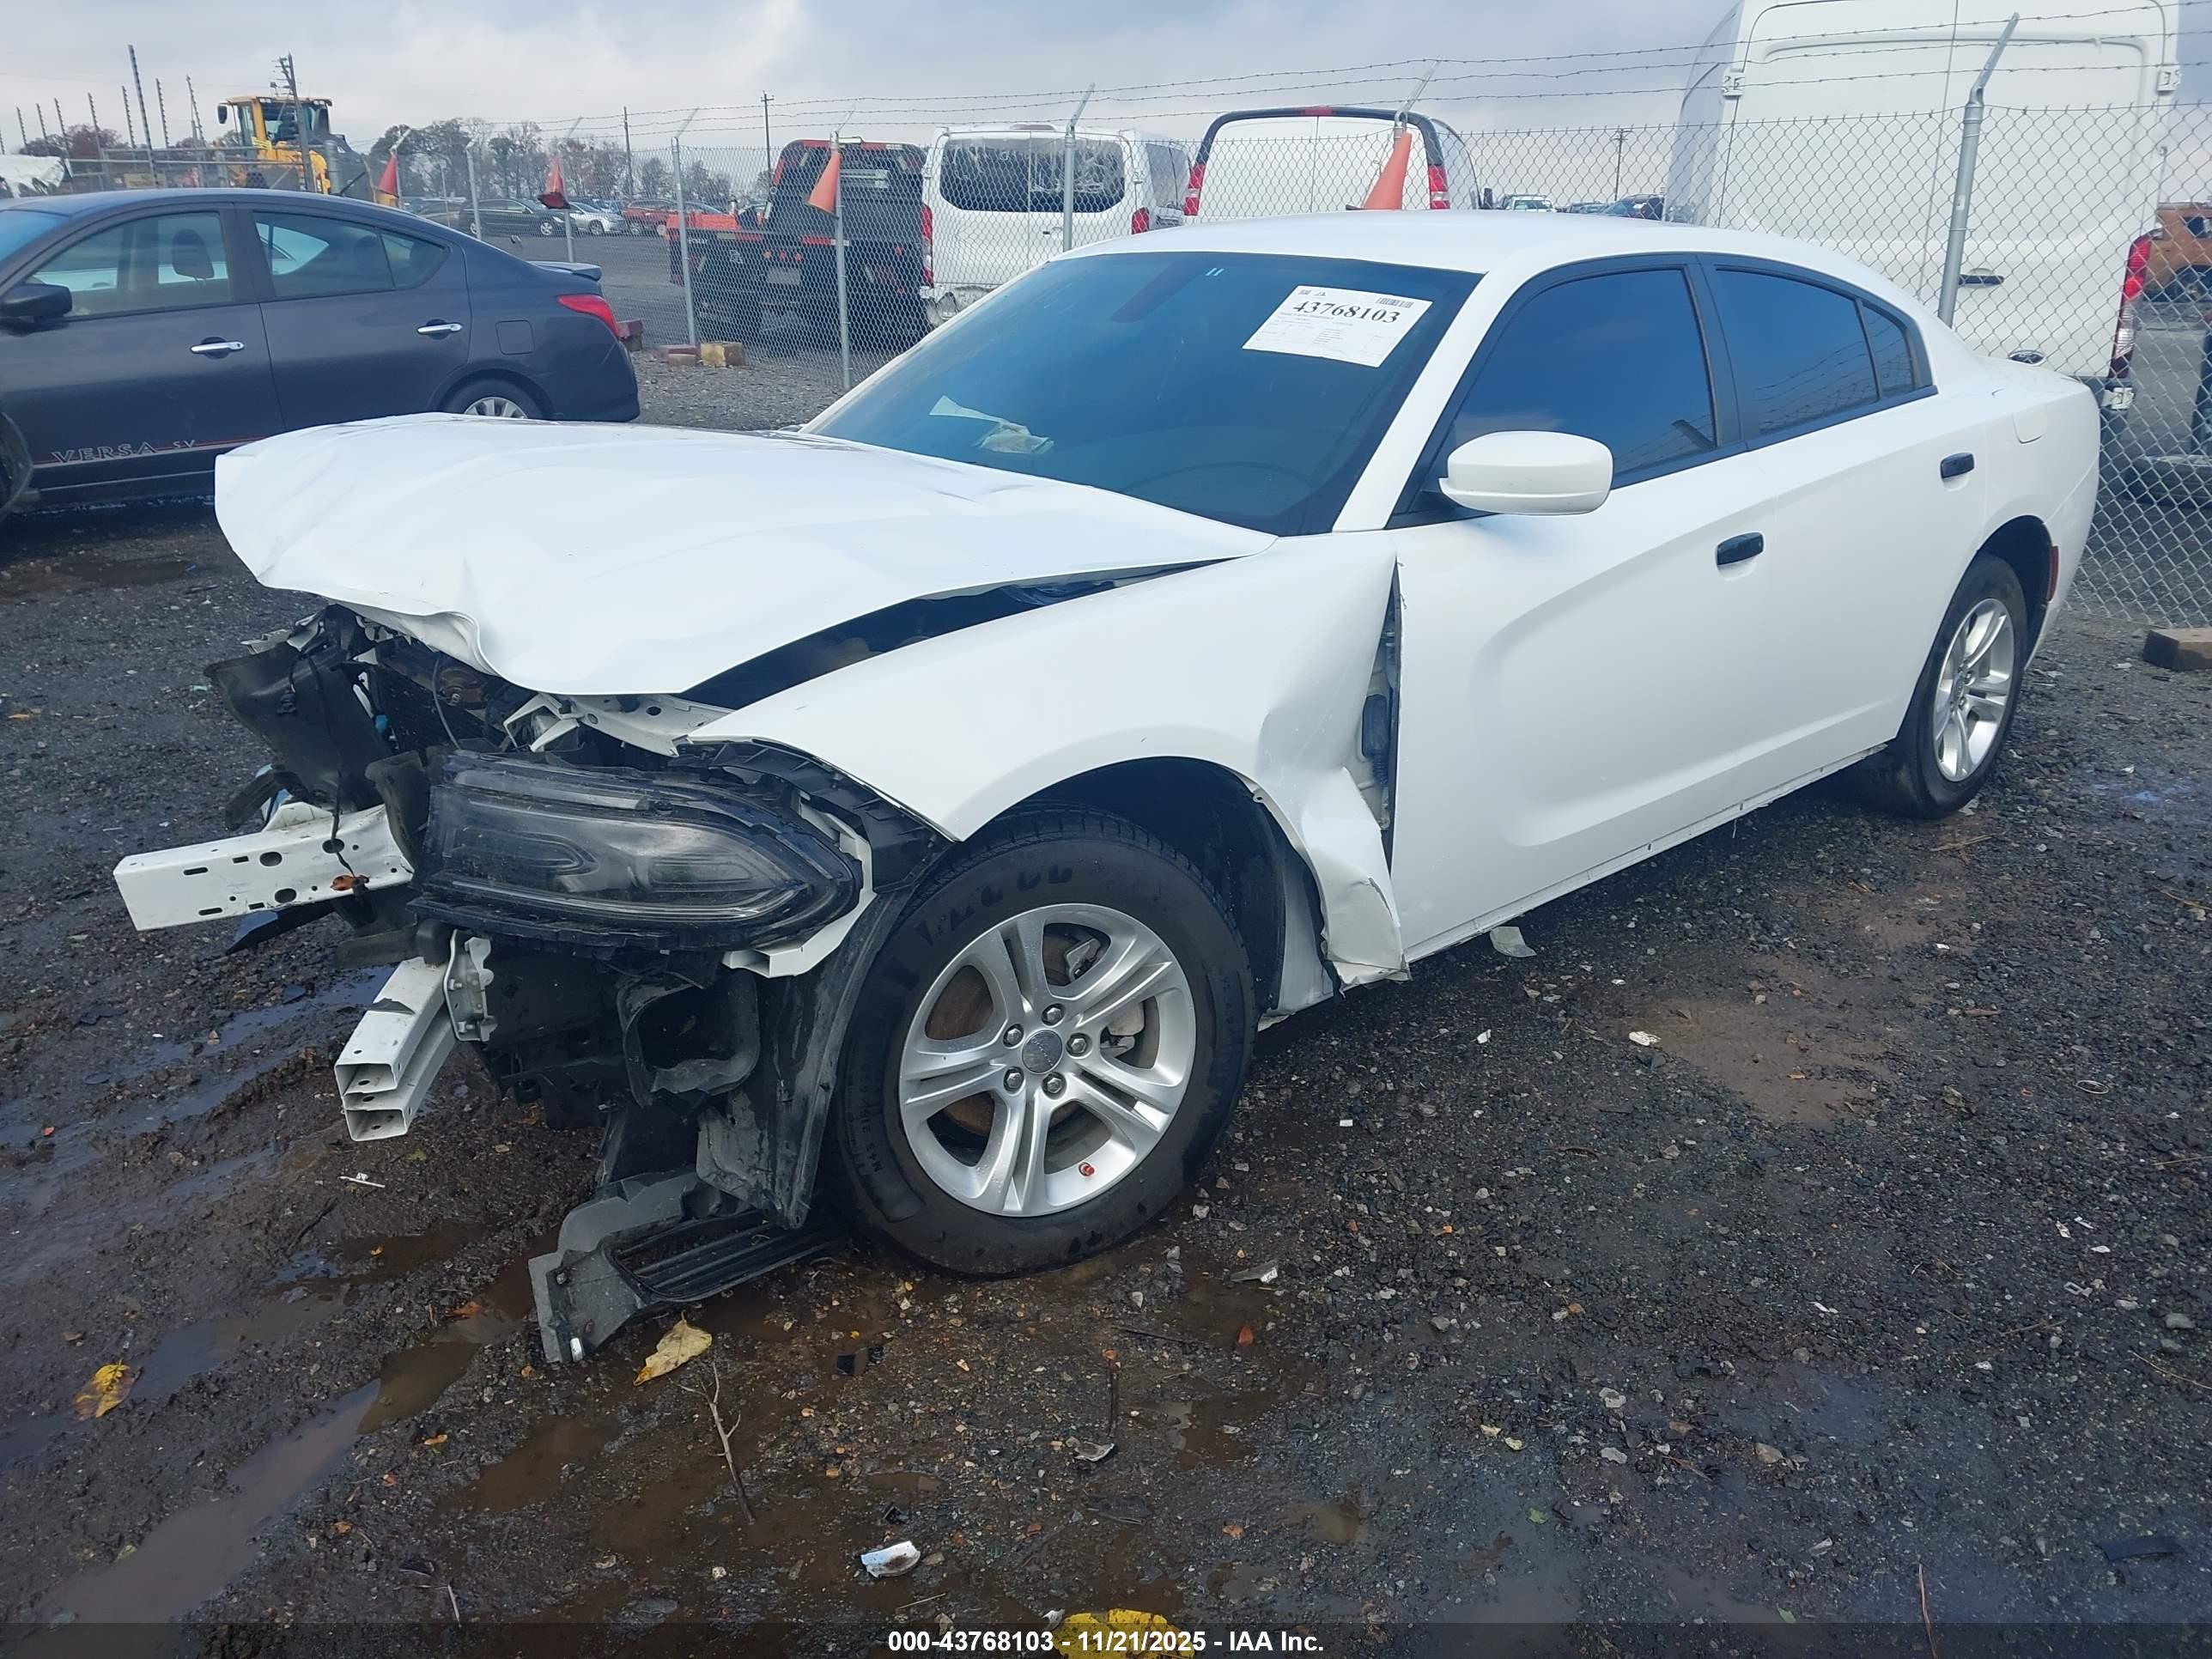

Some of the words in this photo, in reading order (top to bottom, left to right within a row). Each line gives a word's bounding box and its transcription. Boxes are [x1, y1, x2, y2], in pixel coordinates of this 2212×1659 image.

[1292, 301, 1401, 324] 43768103
[50, 441, 158, 464] VERSA
[172, 439, 197, 448] SV
